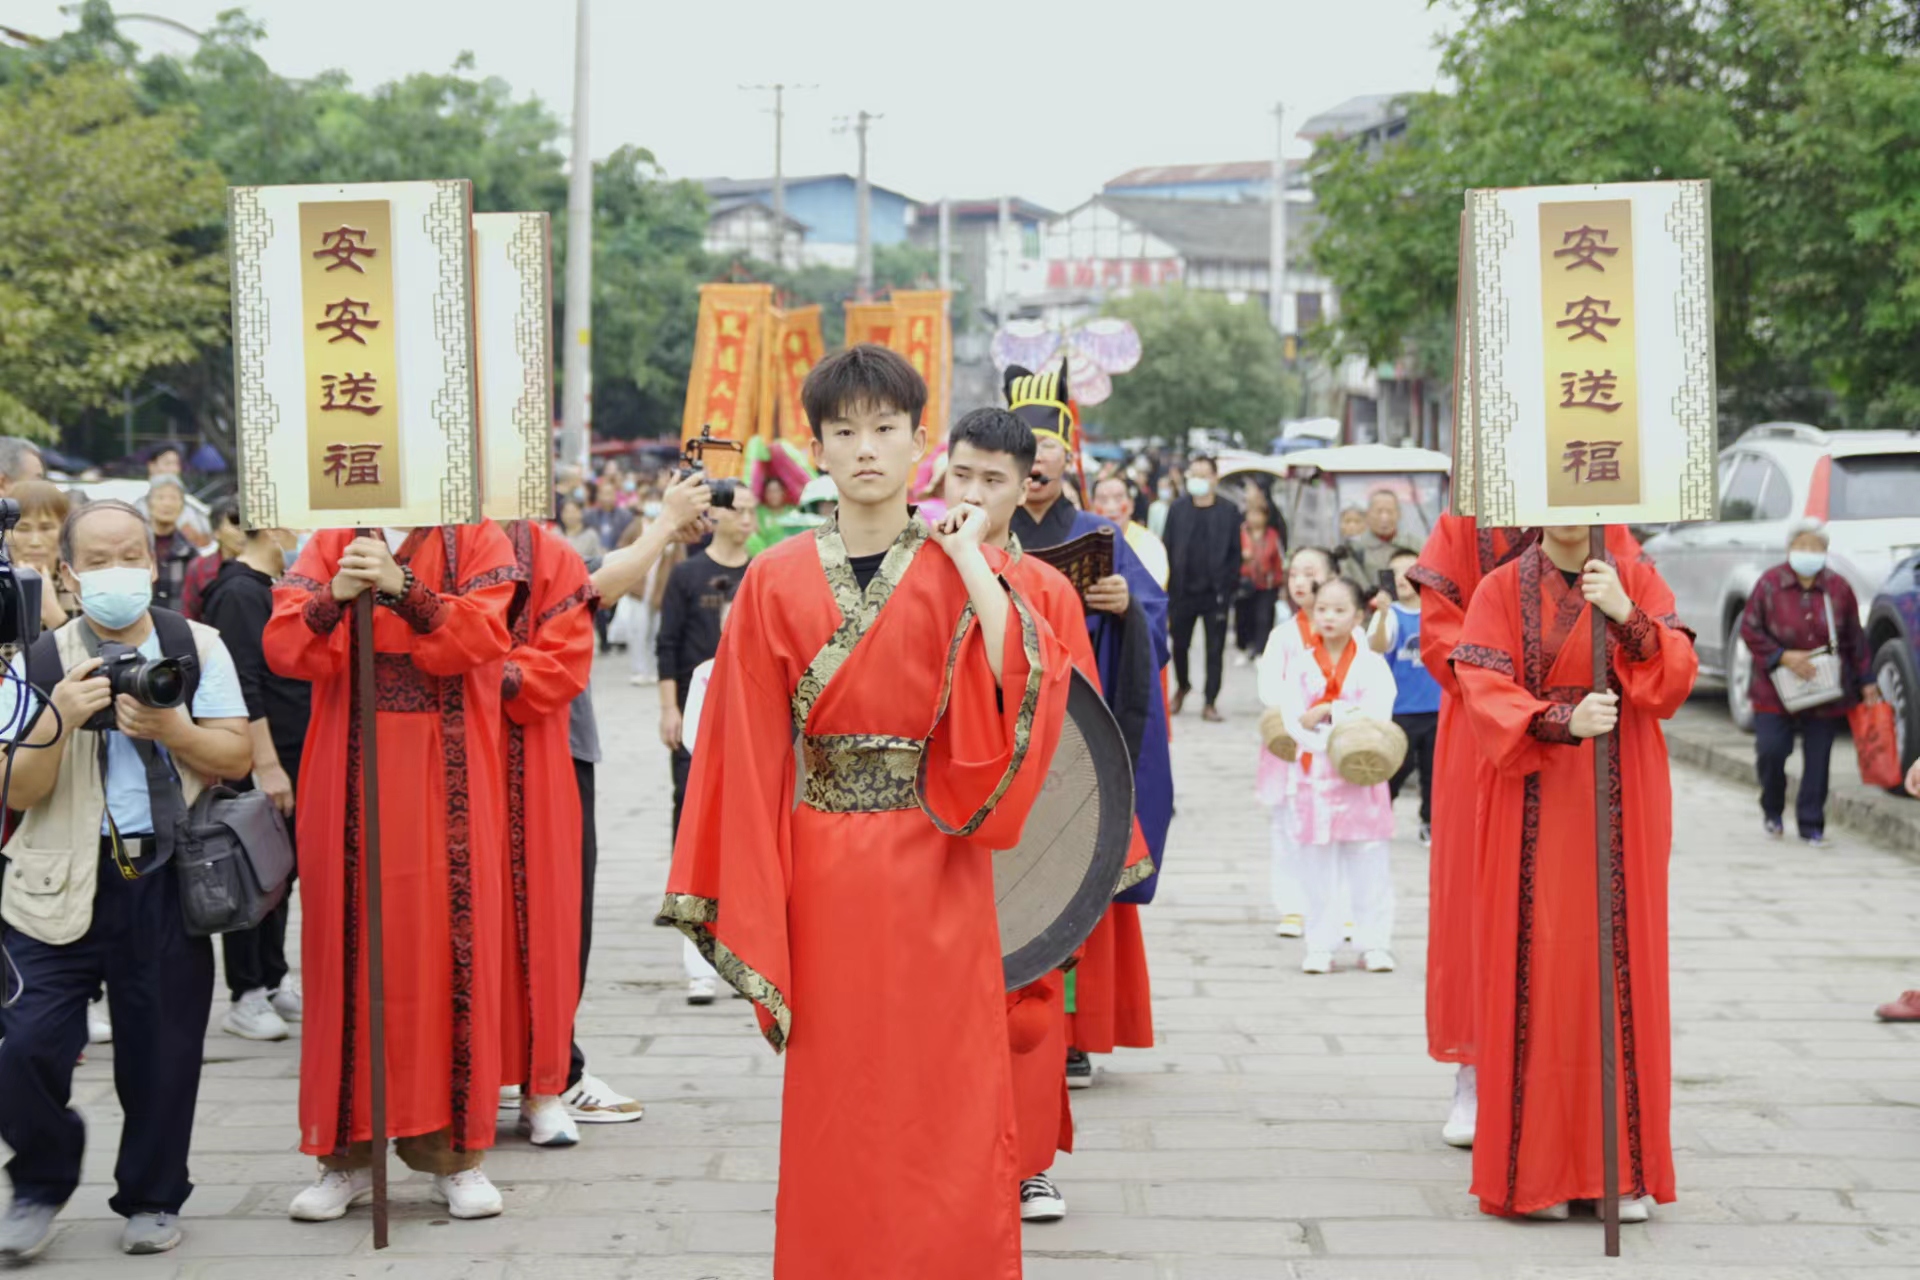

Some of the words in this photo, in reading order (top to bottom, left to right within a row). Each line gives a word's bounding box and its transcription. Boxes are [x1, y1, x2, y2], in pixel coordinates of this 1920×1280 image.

[313, 225, 383, 488] 安安送福
[1553, 224, 1623, 484] 安安送福
